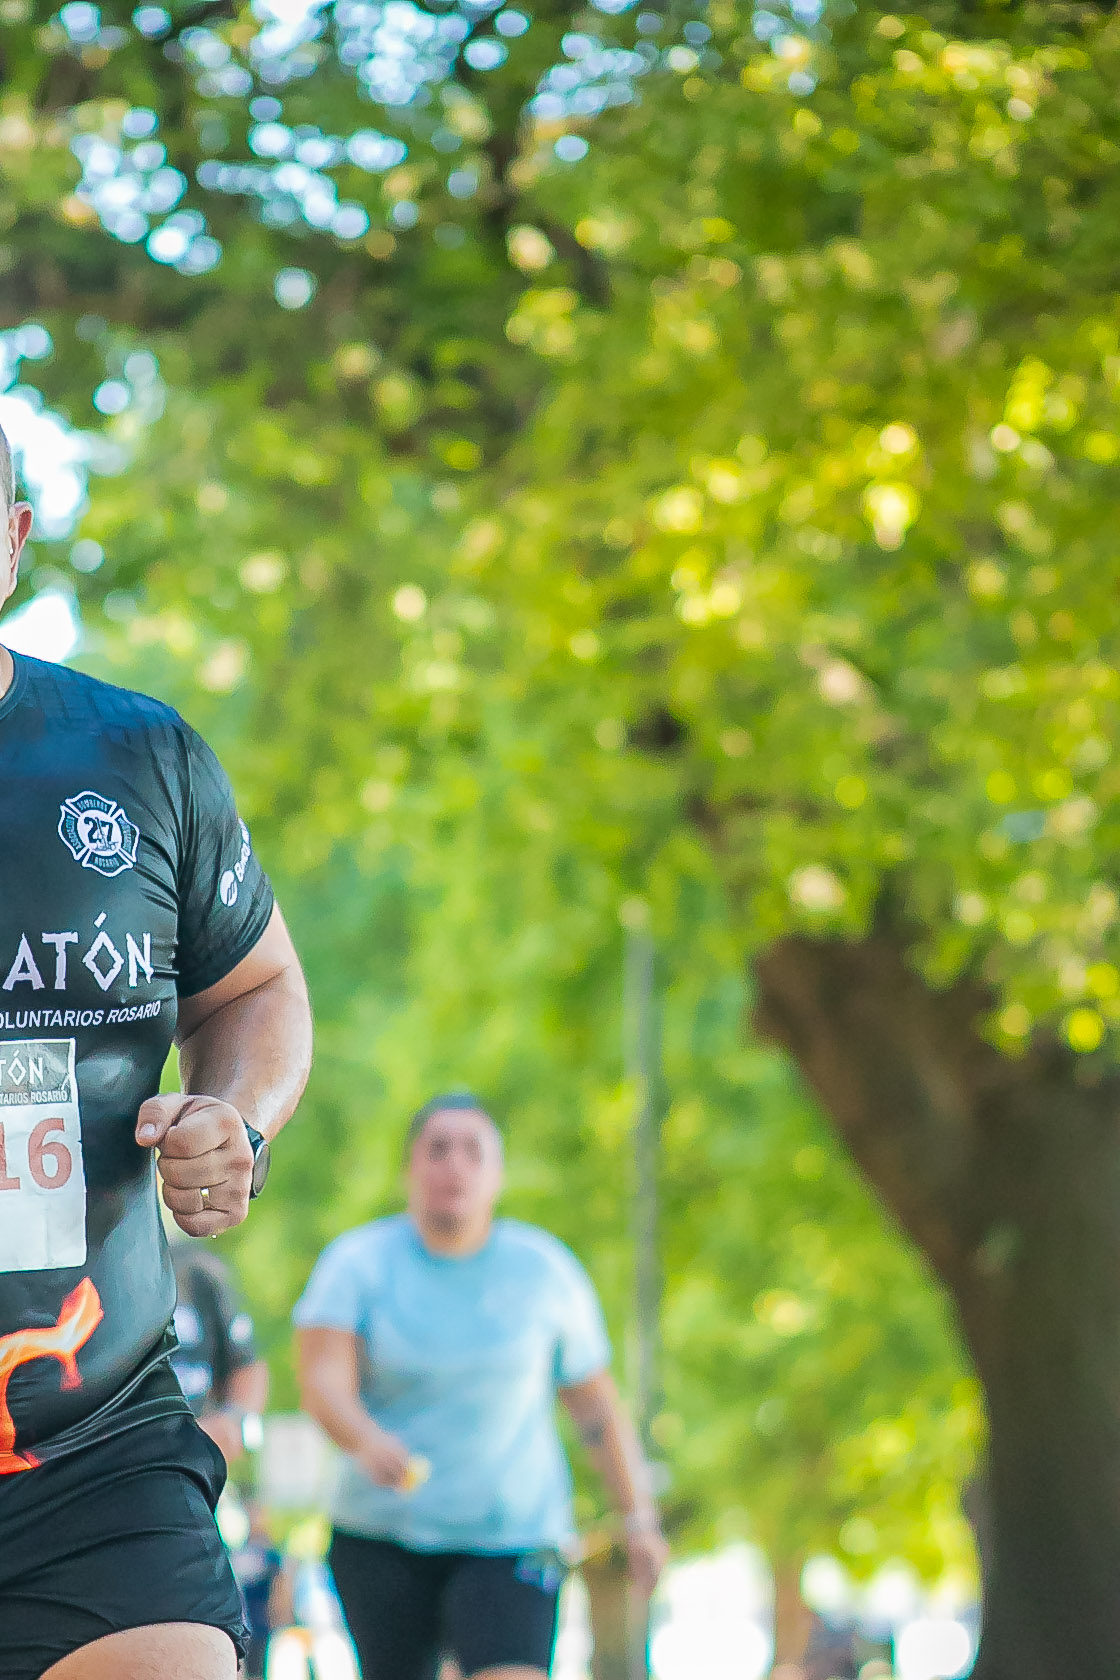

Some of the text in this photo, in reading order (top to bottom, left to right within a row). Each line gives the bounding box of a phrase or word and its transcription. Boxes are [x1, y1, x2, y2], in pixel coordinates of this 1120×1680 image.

[83, 816, 114, 844] 27
[105, 1000, 161, 1025] ROSARIO
[30, 1090, 68, 1103] ROSARIO
